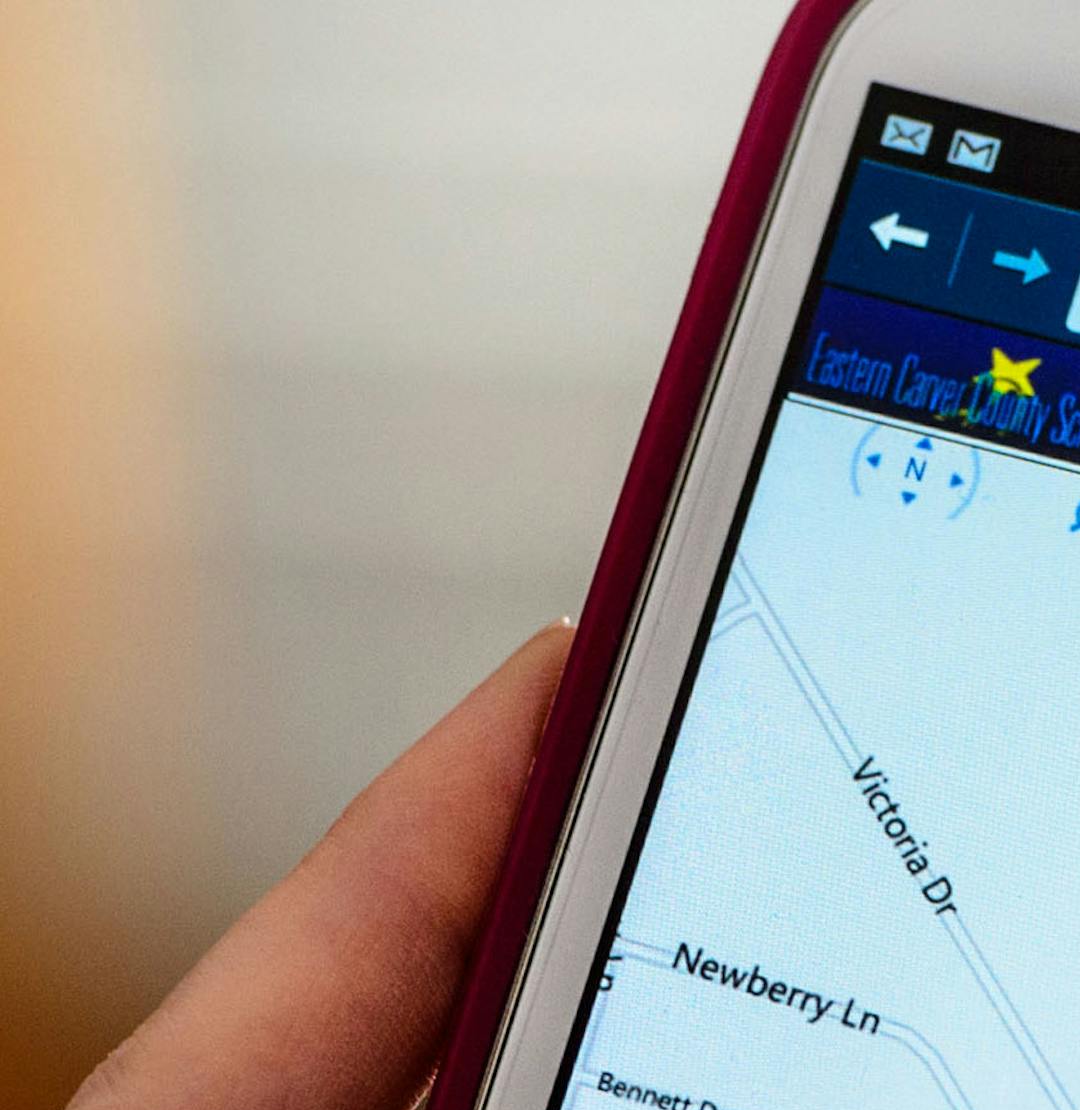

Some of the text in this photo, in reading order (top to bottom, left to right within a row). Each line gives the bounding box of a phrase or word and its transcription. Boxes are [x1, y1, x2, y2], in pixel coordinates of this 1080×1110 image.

[807, 331, 893, 400] Eastern
[892, 354, 968, 417] Carver
[967, 370, 1051, 444] County
[905, 456, 929, 482] N
[853, 756, 957, 916] Victoria Dr
[672, 942, 834, 1024] Newberry
[840, 998, 881, 1036] Ln
